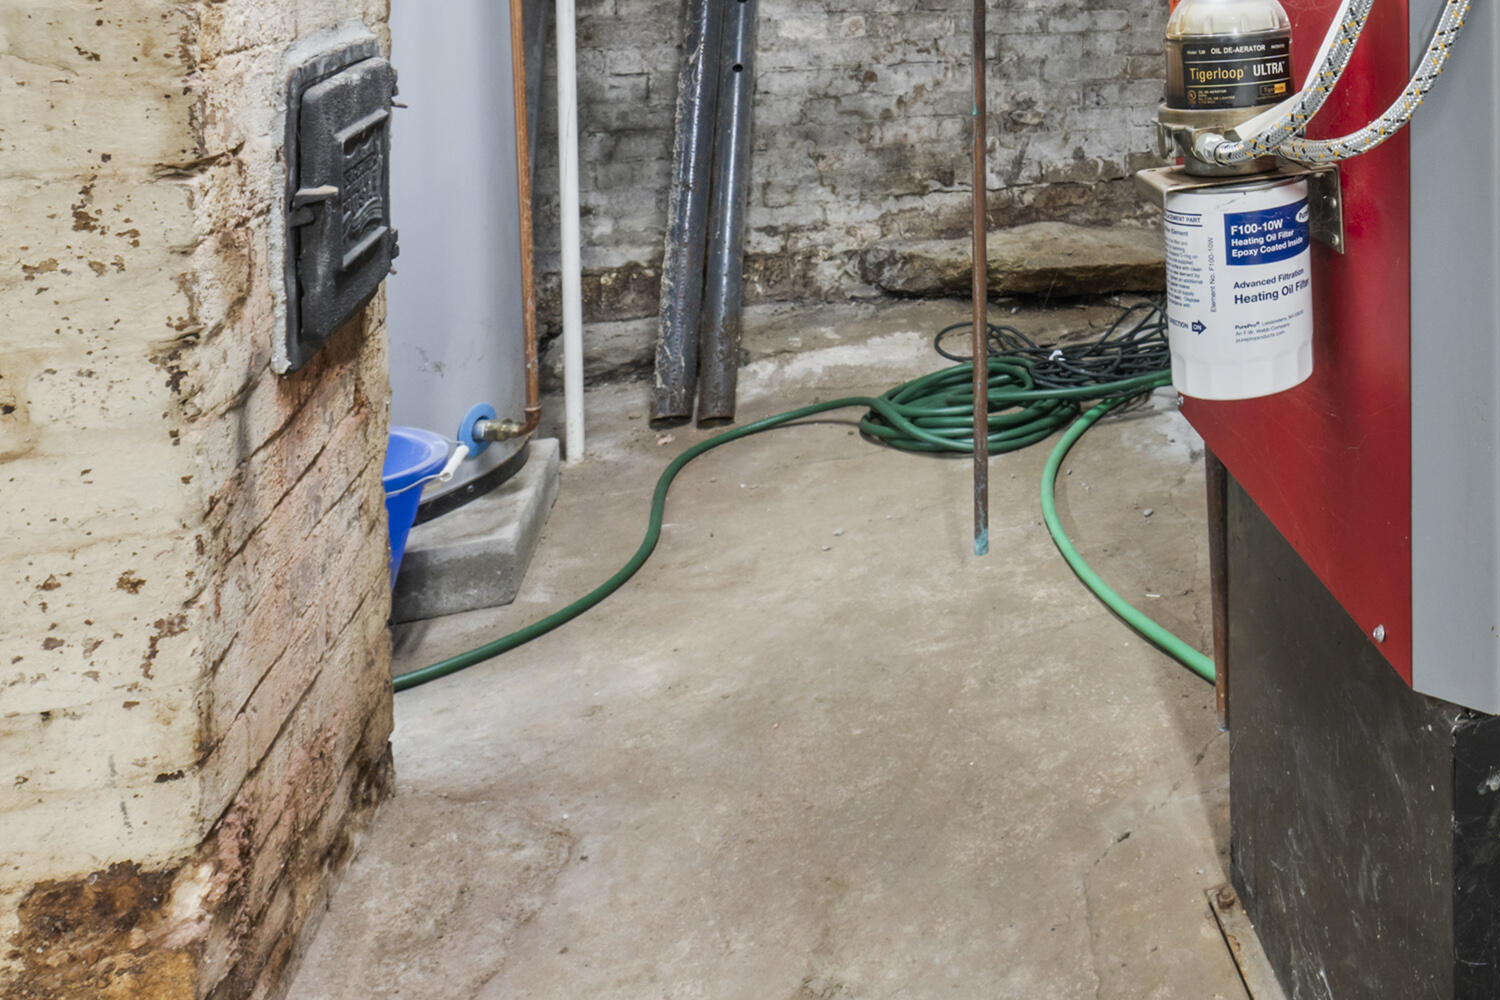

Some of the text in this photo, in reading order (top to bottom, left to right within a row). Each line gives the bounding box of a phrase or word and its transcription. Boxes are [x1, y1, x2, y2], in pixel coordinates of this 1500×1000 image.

[1188, 67, 1245, 82] Tigerloop
[1230, 219, 1284, 235] F100-10W
[1230, 229, 1295, 248] Heating Oil Filter
[1231, 248, 1259, 259] Epoxy
[1260, 242, 1287, 254] Coated
[1233, 267, 1305, 290] Advanced Filtration
[1233, 288, 1280, 304] Heating
[1281, 285, 1294, 297] Oil
